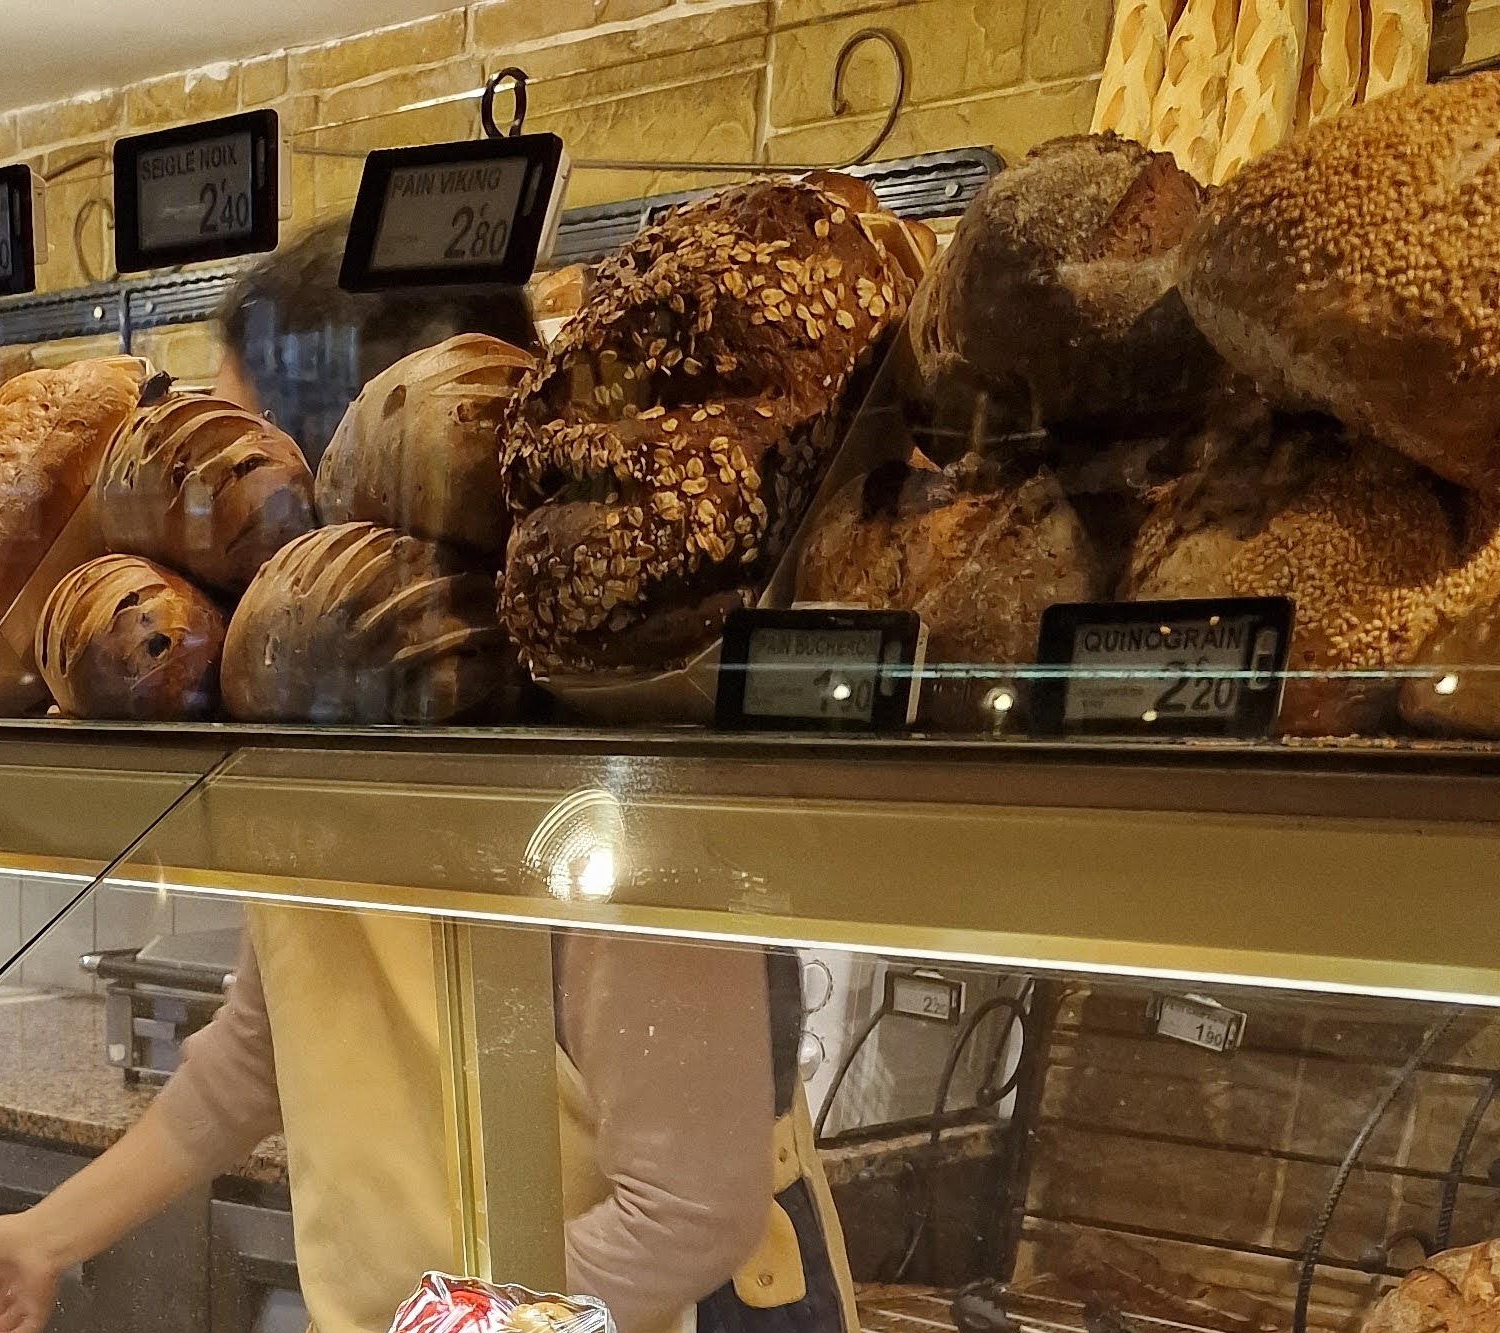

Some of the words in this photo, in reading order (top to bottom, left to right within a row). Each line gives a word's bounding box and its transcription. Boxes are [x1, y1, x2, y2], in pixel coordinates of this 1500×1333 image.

[141, 150, 196, 180] SEIGLE
[200, 144, 238, 171] NOIX
[391, 172, 435, 198] PAIN
[440, 168, 501, 194] VIKING
[1084, 626, 1241, 652] QUINOGRAIN
